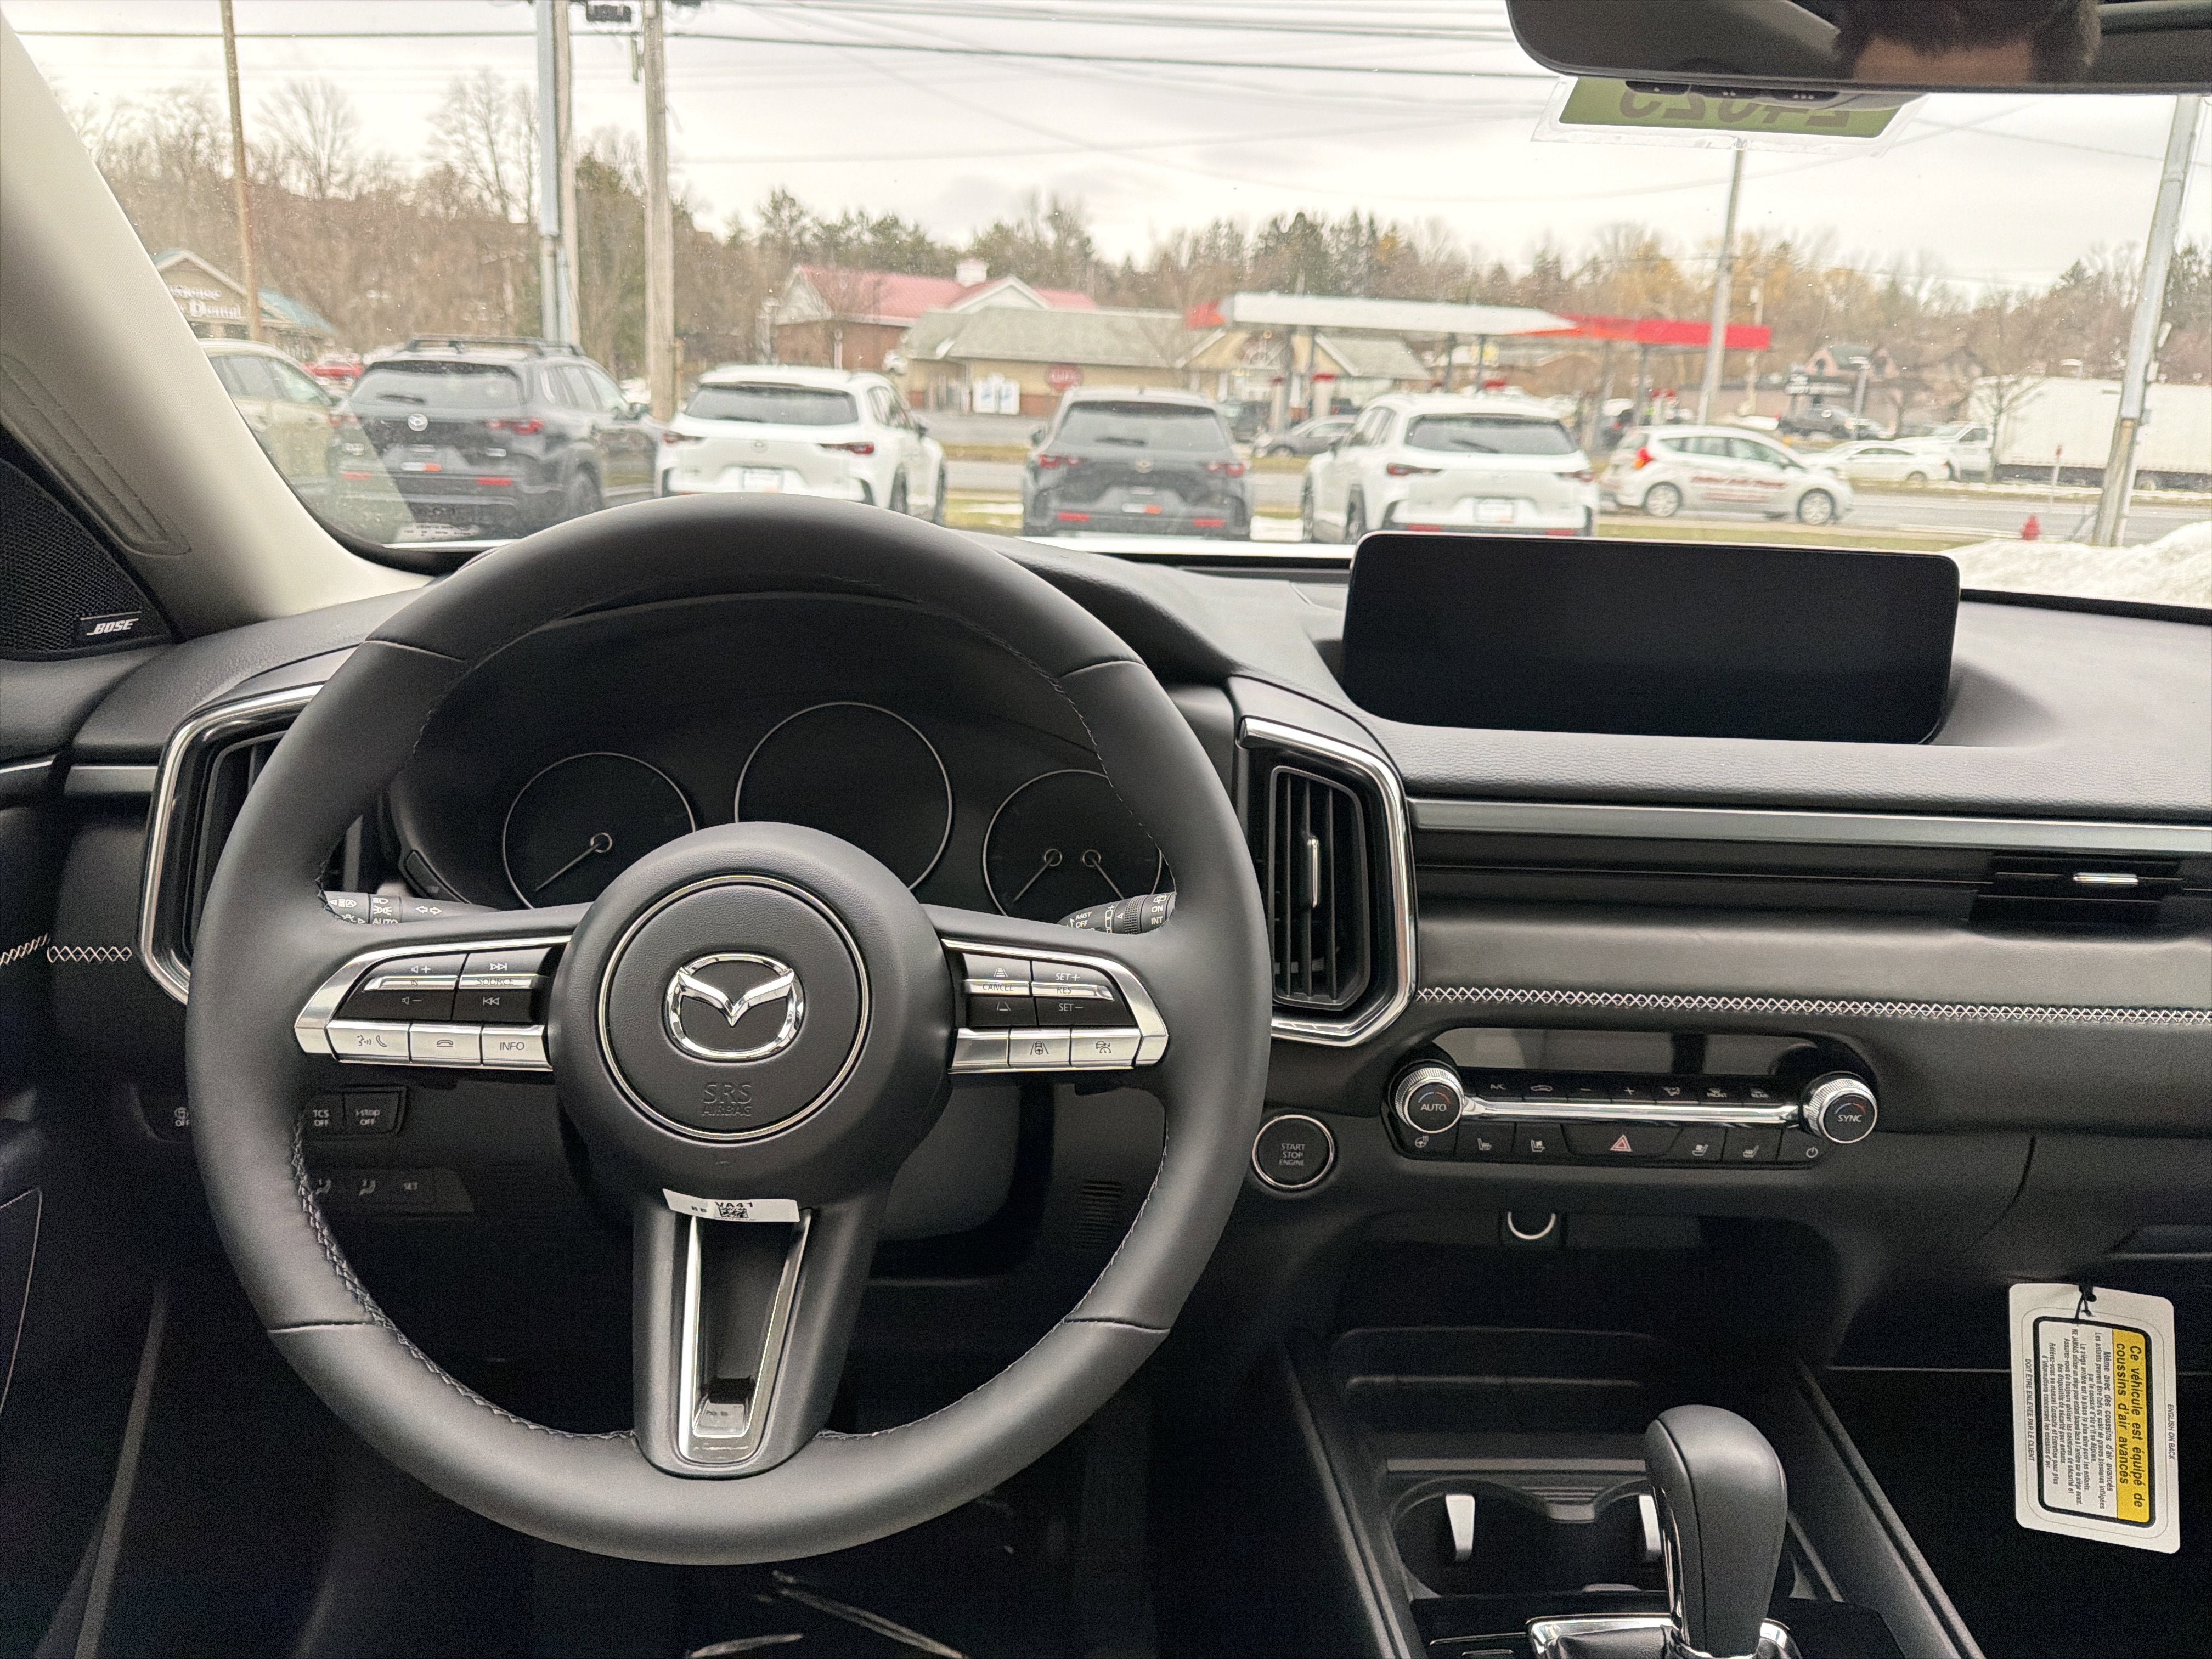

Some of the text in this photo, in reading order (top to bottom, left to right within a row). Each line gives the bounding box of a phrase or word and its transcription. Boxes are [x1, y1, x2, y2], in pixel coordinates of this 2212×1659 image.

[86, 618, 139, 636] BOSE
[1075, 911, 1093, 921] MIST
[1151, 916, 1163, 925] INT
[1075, 920, 1088, 928] OFF
[476, 977, 515, 986] SOURCE
[982, 983, 1014, 992] CANCEL
[1056, 986, 1072, 995] RES
[500, 1041, 525, 1051] INFO
[702, 1083, 752, 1104] SRS
[701, 1105, 752, 1116] AIRBAG
[1420, 1103, 1447, 1112] AUTO
[313, 1109, 329, 1118] TCS
[1837, 1114, 1863, 1123] SYNC
[314, 1119, 329, 1127] OFF
[1281, 1143, 1306, 1151] START
[2103, 1351, 2111, 1372] Même
[2116, 1342, 2129, 1396] coussins
[2104, 1394, 2112, 1407] des
[2104, 1410, 2113, 1442] coussins
[2129, 1345, 2145, 1508] Ce véhicule est équipé de
[2027, 1431, 2034, 1439] LE
[2168, 1432, 2175, 1442] ON
[2118, 1436, 2131, 1485] avancés
[2106, 1463, 2114, 1492] avancés
